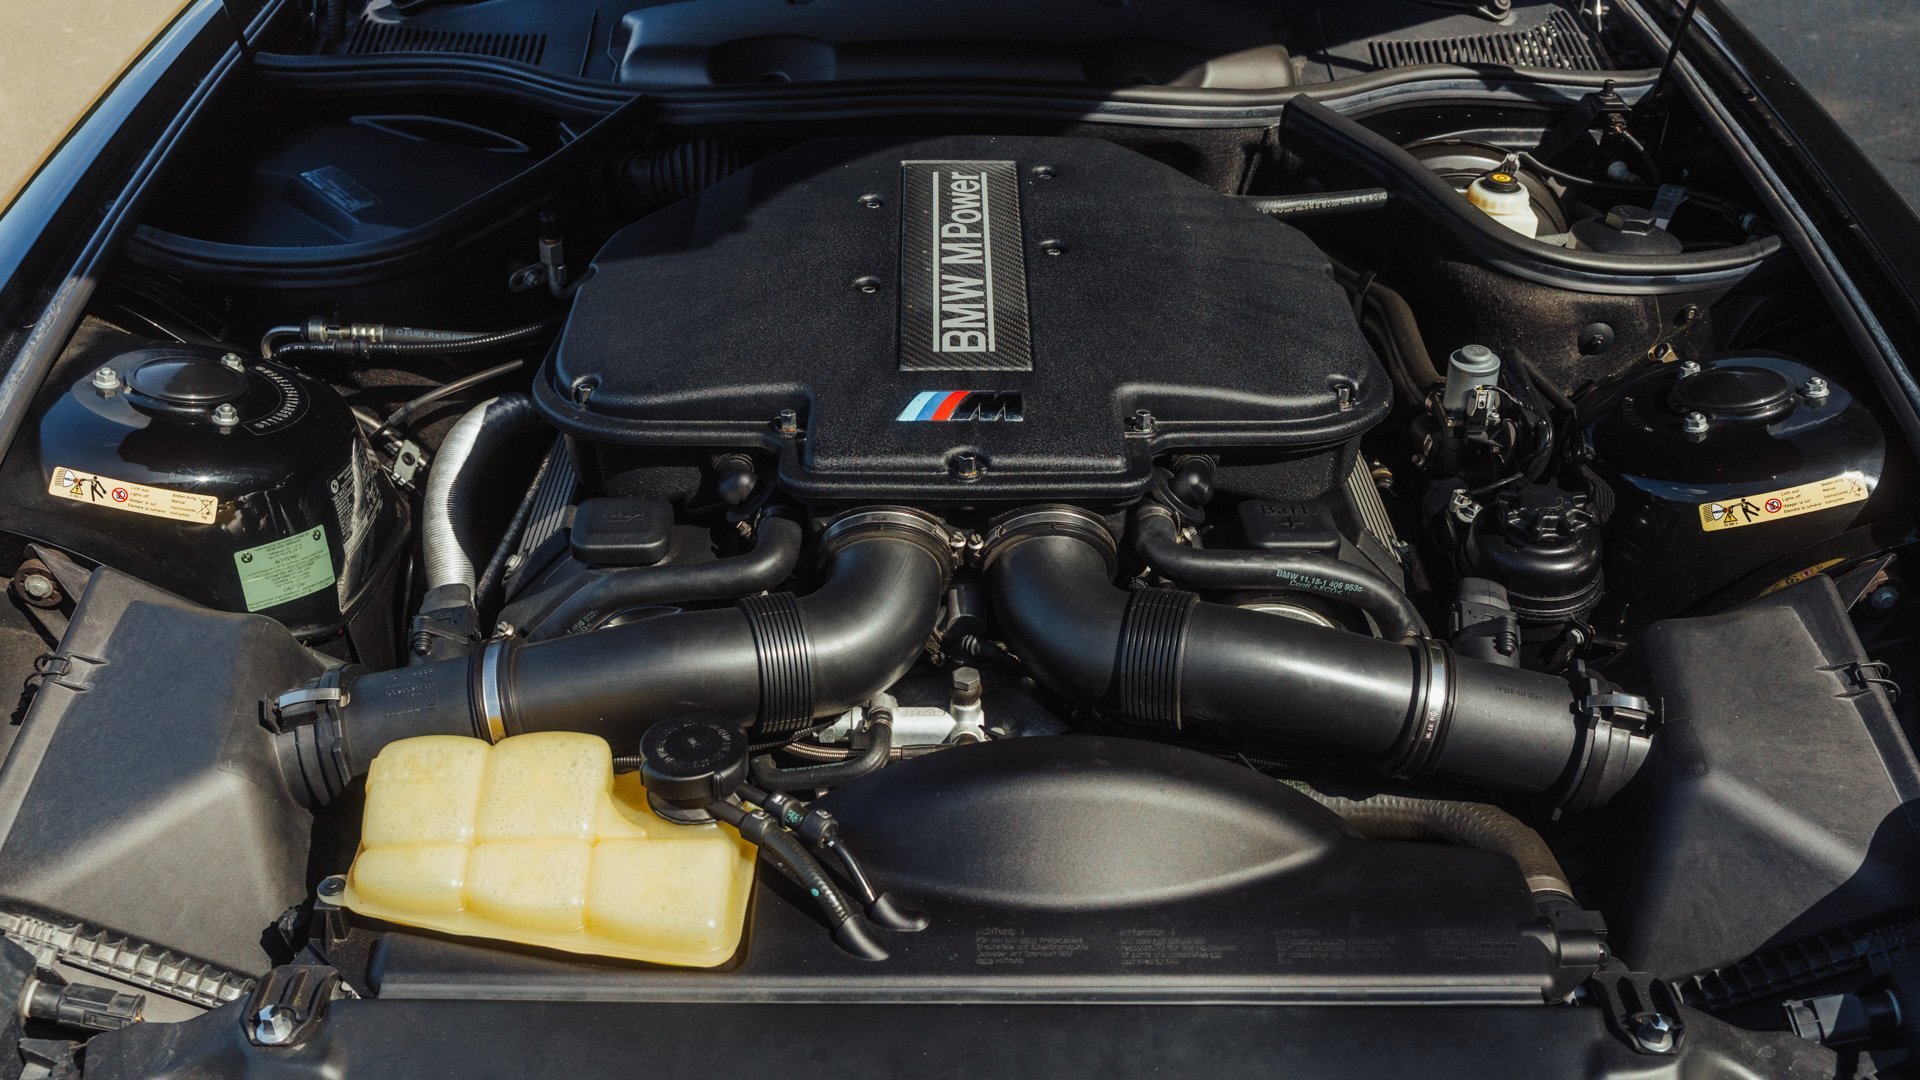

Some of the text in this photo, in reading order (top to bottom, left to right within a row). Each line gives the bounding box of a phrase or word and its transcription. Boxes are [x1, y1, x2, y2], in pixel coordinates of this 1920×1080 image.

[941, 274, 987, 352] BMW
[404, 329, 426, 337] FUEL
[1276, 569, 1299, 580] BMW
